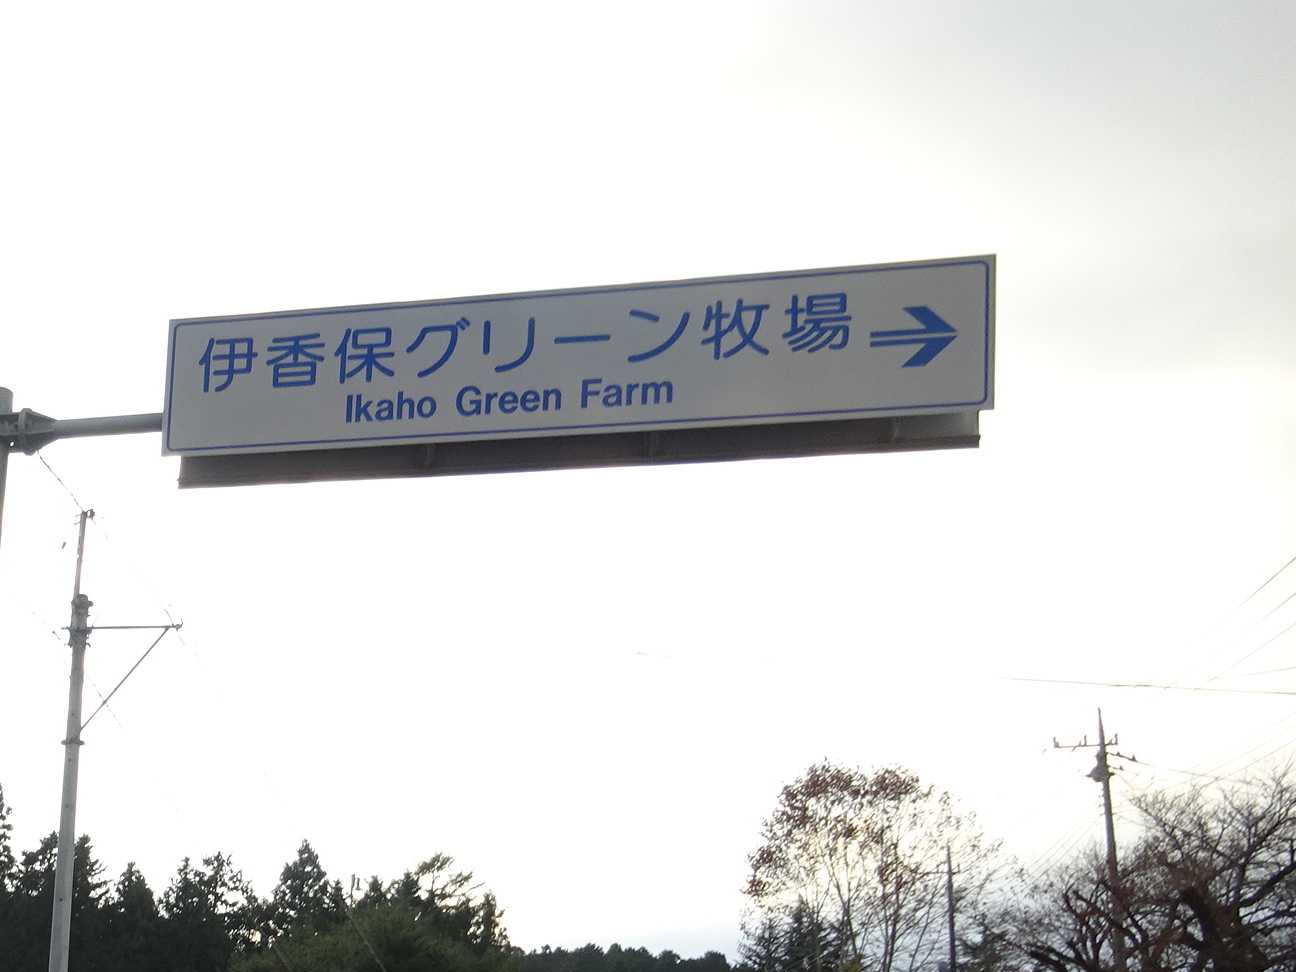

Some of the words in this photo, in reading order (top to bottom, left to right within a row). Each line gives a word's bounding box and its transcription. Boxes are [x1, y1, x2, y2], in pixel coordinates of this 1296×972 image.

[198, 293, 853, 394] 伊香保グリーン牧場
[344, 391, 438, 425] Ikaho
[456, 381, 562, 418] Green
[581, 377, 674, 410] Farm
